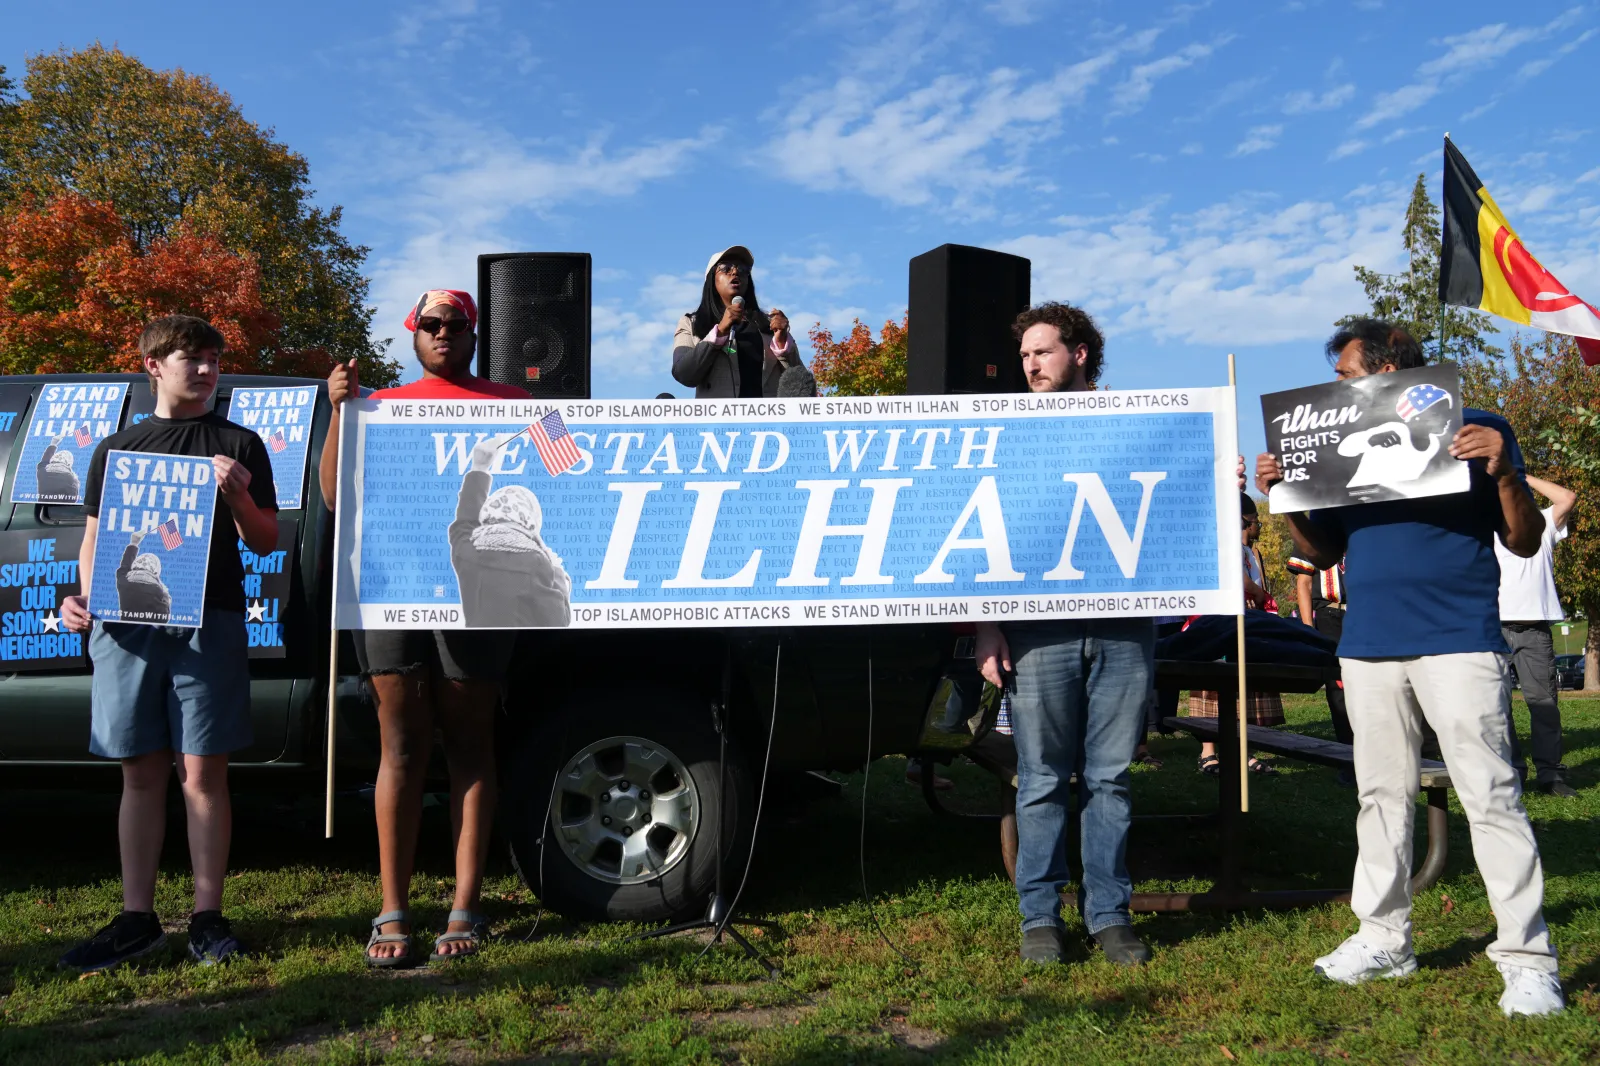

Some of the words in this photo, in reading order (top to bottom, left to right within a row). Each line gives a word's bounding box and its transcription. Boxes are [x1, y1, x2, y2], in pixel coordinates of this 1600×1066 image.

[46, 386, 120, 402] STAND
[238, 390, 309, 408] STAND
[49, 403, 108, 418] WITH
[392, 405, 412, 417] WE
[418, 405, 464, 417] STAND
[470, 406, 505, 417] WITH
[511, 406, 553, 417] ILHAN
[567, 406, 603, 417] STOP
[609, 404, 717, 417] ISLAMOPHOBIC
[722, 404, 786, 416] ATTACKS
[800, 403, 820, 415] WE
[827, 402, 872, 414] STAND
[878, 402, 912, 414] WITH
[918, 401, 959, 413] ILHAN
[972, 400, 1008, 411] STOP
[1014, 397, 1121, 411] ISLAMOPHOBIC
[1127, 394, 1188, 407] ATTACKS
[242, 408, 299, 425] WITH
[258, 426, 304, 442] HAN
[1280, 430, 1340, 451] FIGHTS
[430, 432, 533, 476] WE
[564, 431, 790, 476] STAND
[822, 426, 1005, 474] WITH
[1282, 450, 1317, 467] FOR
[114, 456, 210, 486] STAND
[1284, 468, 1310, 482] US.
[577, 481, 604, 489] LOVE
[122, 482, 198, 510] WITH
[562, 494, 608, 503] RESPECT
[568, 508, 595, 516] LOVE
[564, 535, 590, 543] LOVE
[750, 532, 776, 541] LOVE
[584, 471, 1168, 590] ILHAN
[28, 538, 56, 562] WE
[0, 560, 79, 587] SUPPORT
[21, 586, 56, 610] OUR
[574, 589, 604, 597] UNITY
[611, 588, 658, 597] RESPECT
[734, 586, 784, 596] EQUALITY
[791, 585, 834, 594] JUSTICE
[384, 610, 405, 622] WE
[412, 610, 458, 622] STAND
[574, 609, 602, 621] TOP
[607, 607, 719, 621] ISLAMOPHOBIC
[724, 607, 790, 620] ATTACKS
[804, 606, 826, 618] WE
[832, 605, 879, 618] STAND
[885, 604, 920, 617] WITH
[927, 603, 968, 616] ILHAN
[982, 602, 1018, 614] STOP
[1024, 598, 1130, 613] ISLAMOPHOBIC
[1135, 596, 1196, 610] ATTACKS
[0, 634, 82, 661] NEIGHBOR
